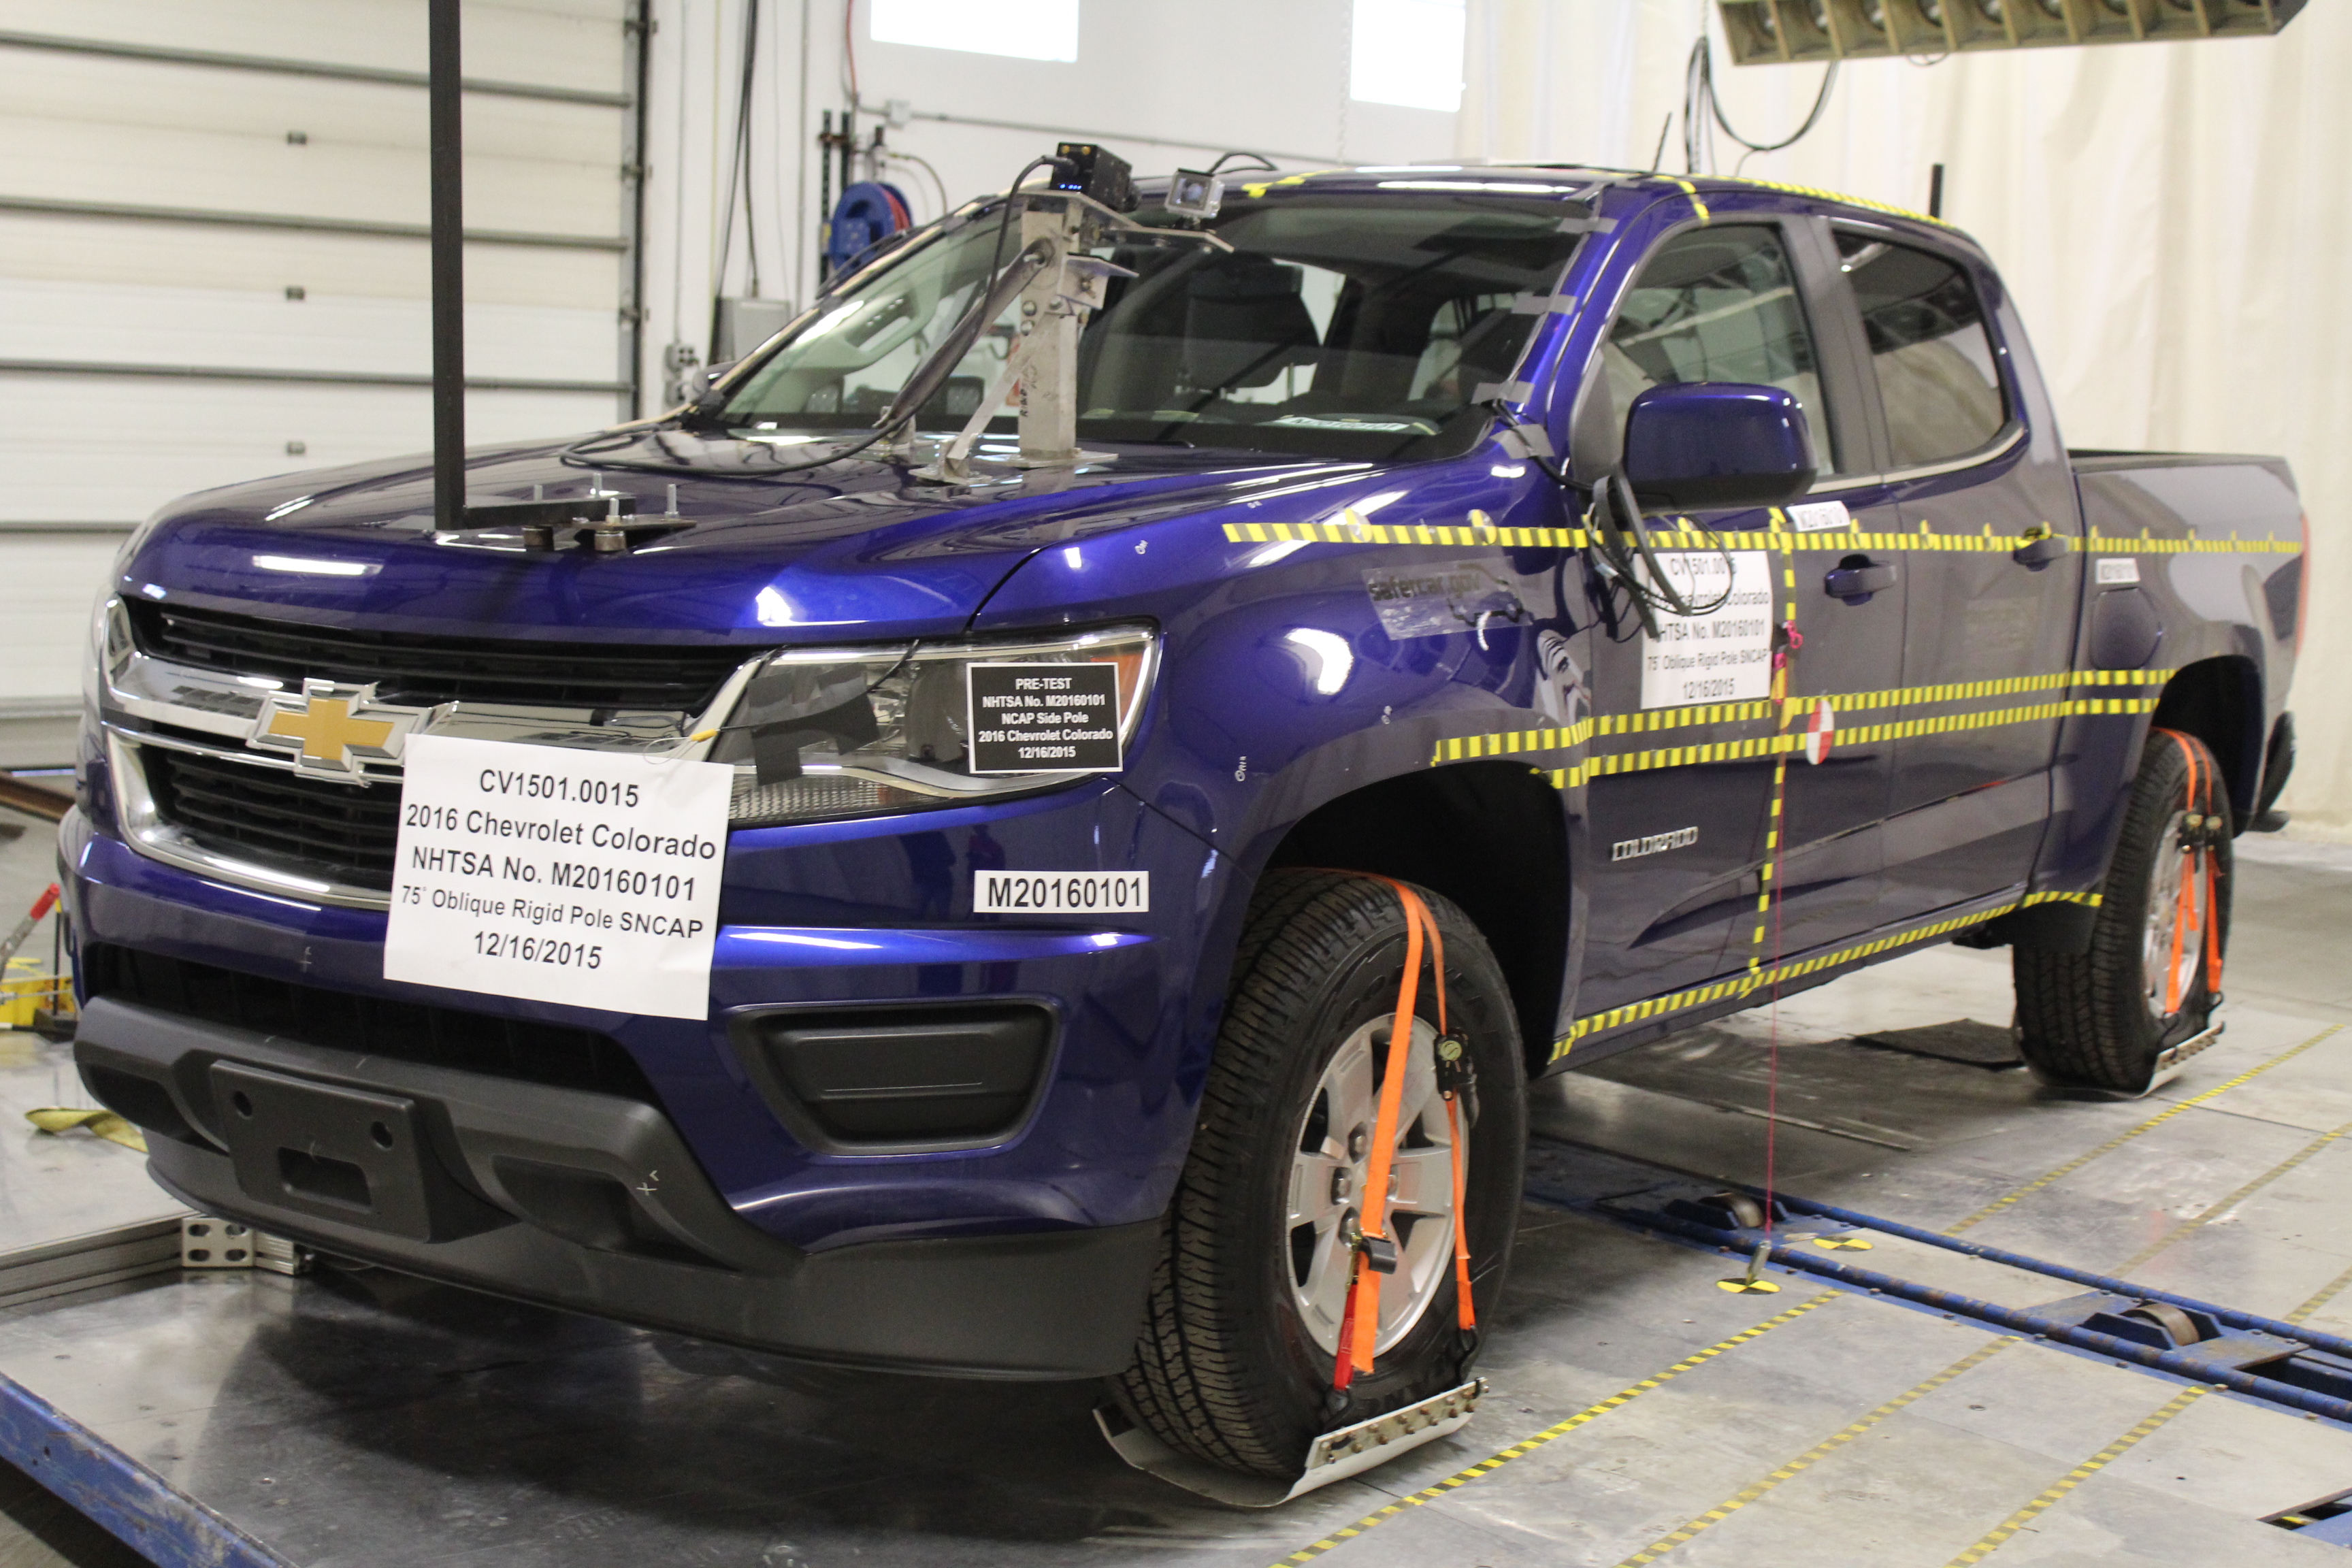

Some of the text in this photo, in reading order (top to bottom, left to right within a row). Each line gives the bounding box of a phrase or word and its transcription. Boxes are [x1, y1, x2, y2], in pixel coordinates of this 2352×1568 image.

[1726, 588, 1769, 605] olorado
[1656, 623, 1688, 640] HTSA
[1663, 653, 1695, 672] Oblique
[1697, 652, 1718, 670] Rigid
[1721, 651, 1737, 665] Pole
[1015, 678, 1072, 690] PRE-TEST
[982, 694, 1105, 708] NHTSA No. M20160101
[1002, 711, 1089, 725] NCAP Side Pole
[979, 728, 1113, 742] 2016 Chevrolet Colorado
[1018, 746, 1076, 759] 12/16/2015
[479, 768, 640, 808] CV1501.0015
[406, 803, 717, 860] 2016 Chevrolet Colorado
[412, 845, 696, 901] NHTSA No. M20160101
[988, 877, 1141, 907] M20160101
[431, 888, 505, 917] Oblique
[512, 898, 564, 926] Rigid
[570, 905, 613, 929] Pole
[619, 912, 703, 938] SNCAP
[474, 930, 603, 969] 12/16/2015
